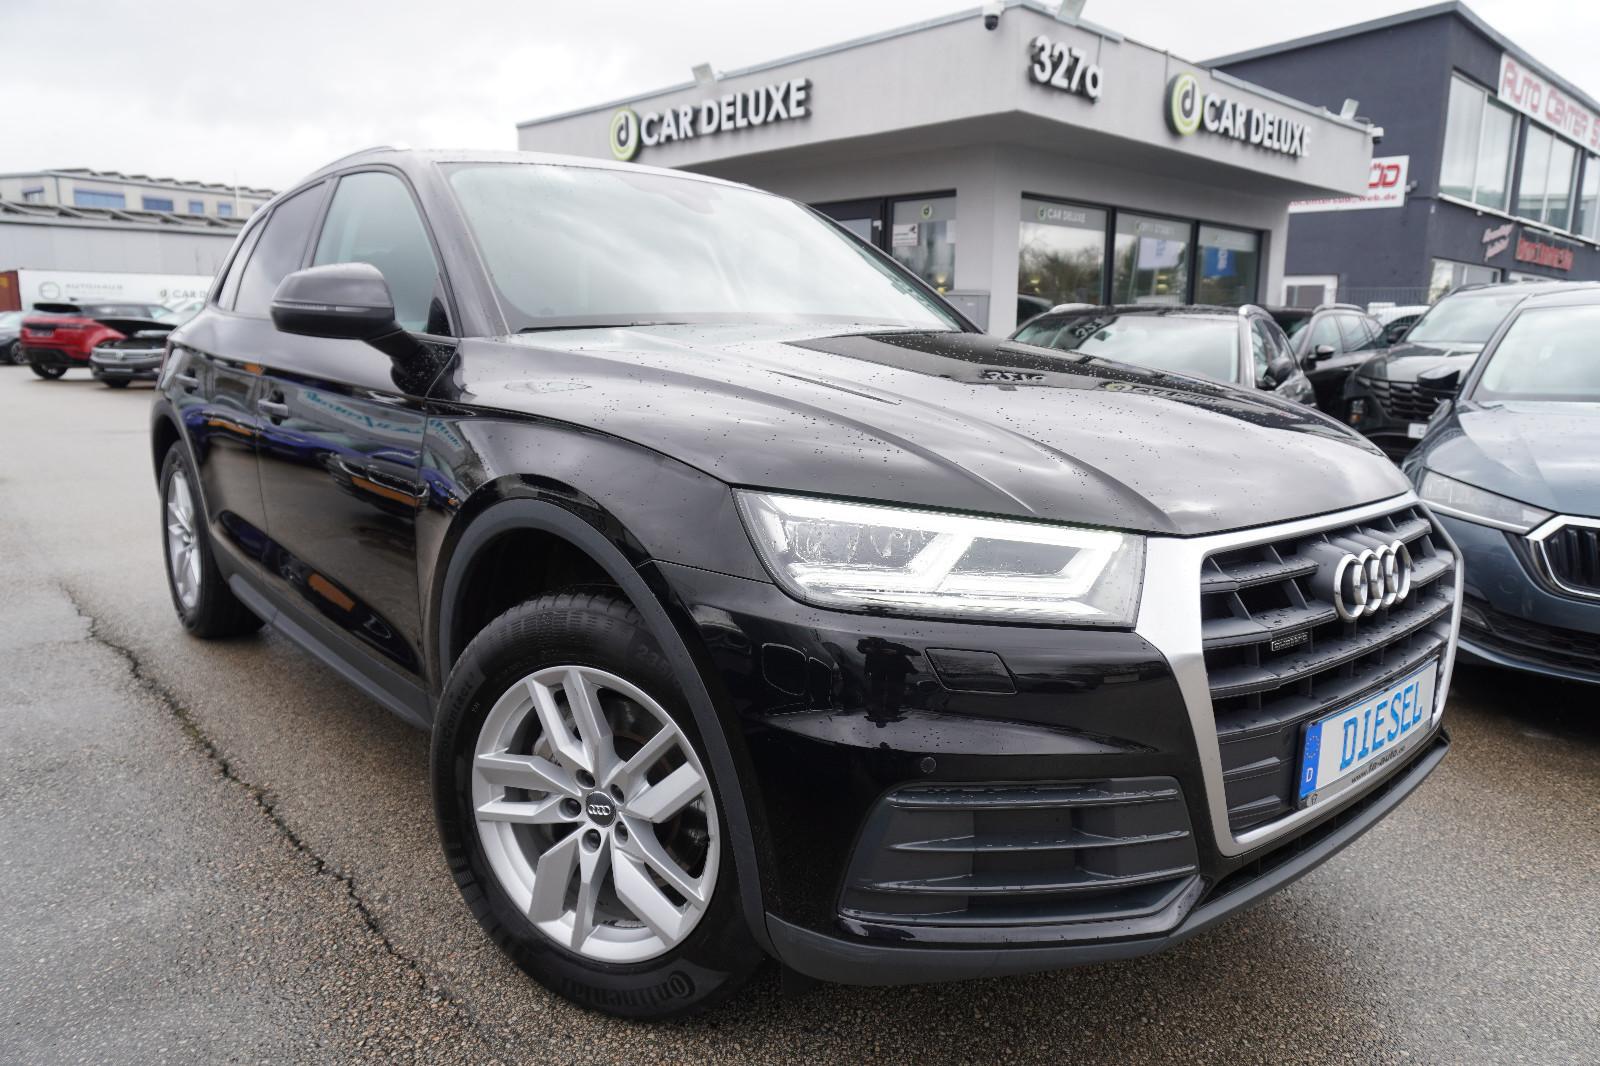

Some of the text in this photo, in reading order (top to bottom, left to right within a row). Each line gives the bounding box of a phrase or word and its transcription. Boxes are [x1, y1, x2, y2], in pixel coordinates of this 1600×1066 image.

[640, 104, 694, 146] CAR
[699, 78, 807, 135] DELUXE
[1203, 92, 1247, 141] CAR
[1249, 108, 1312, 157] DELUXE
[1340, 681, 1422, 771] DIESEL
[1306, 768, 1313, 782] D
